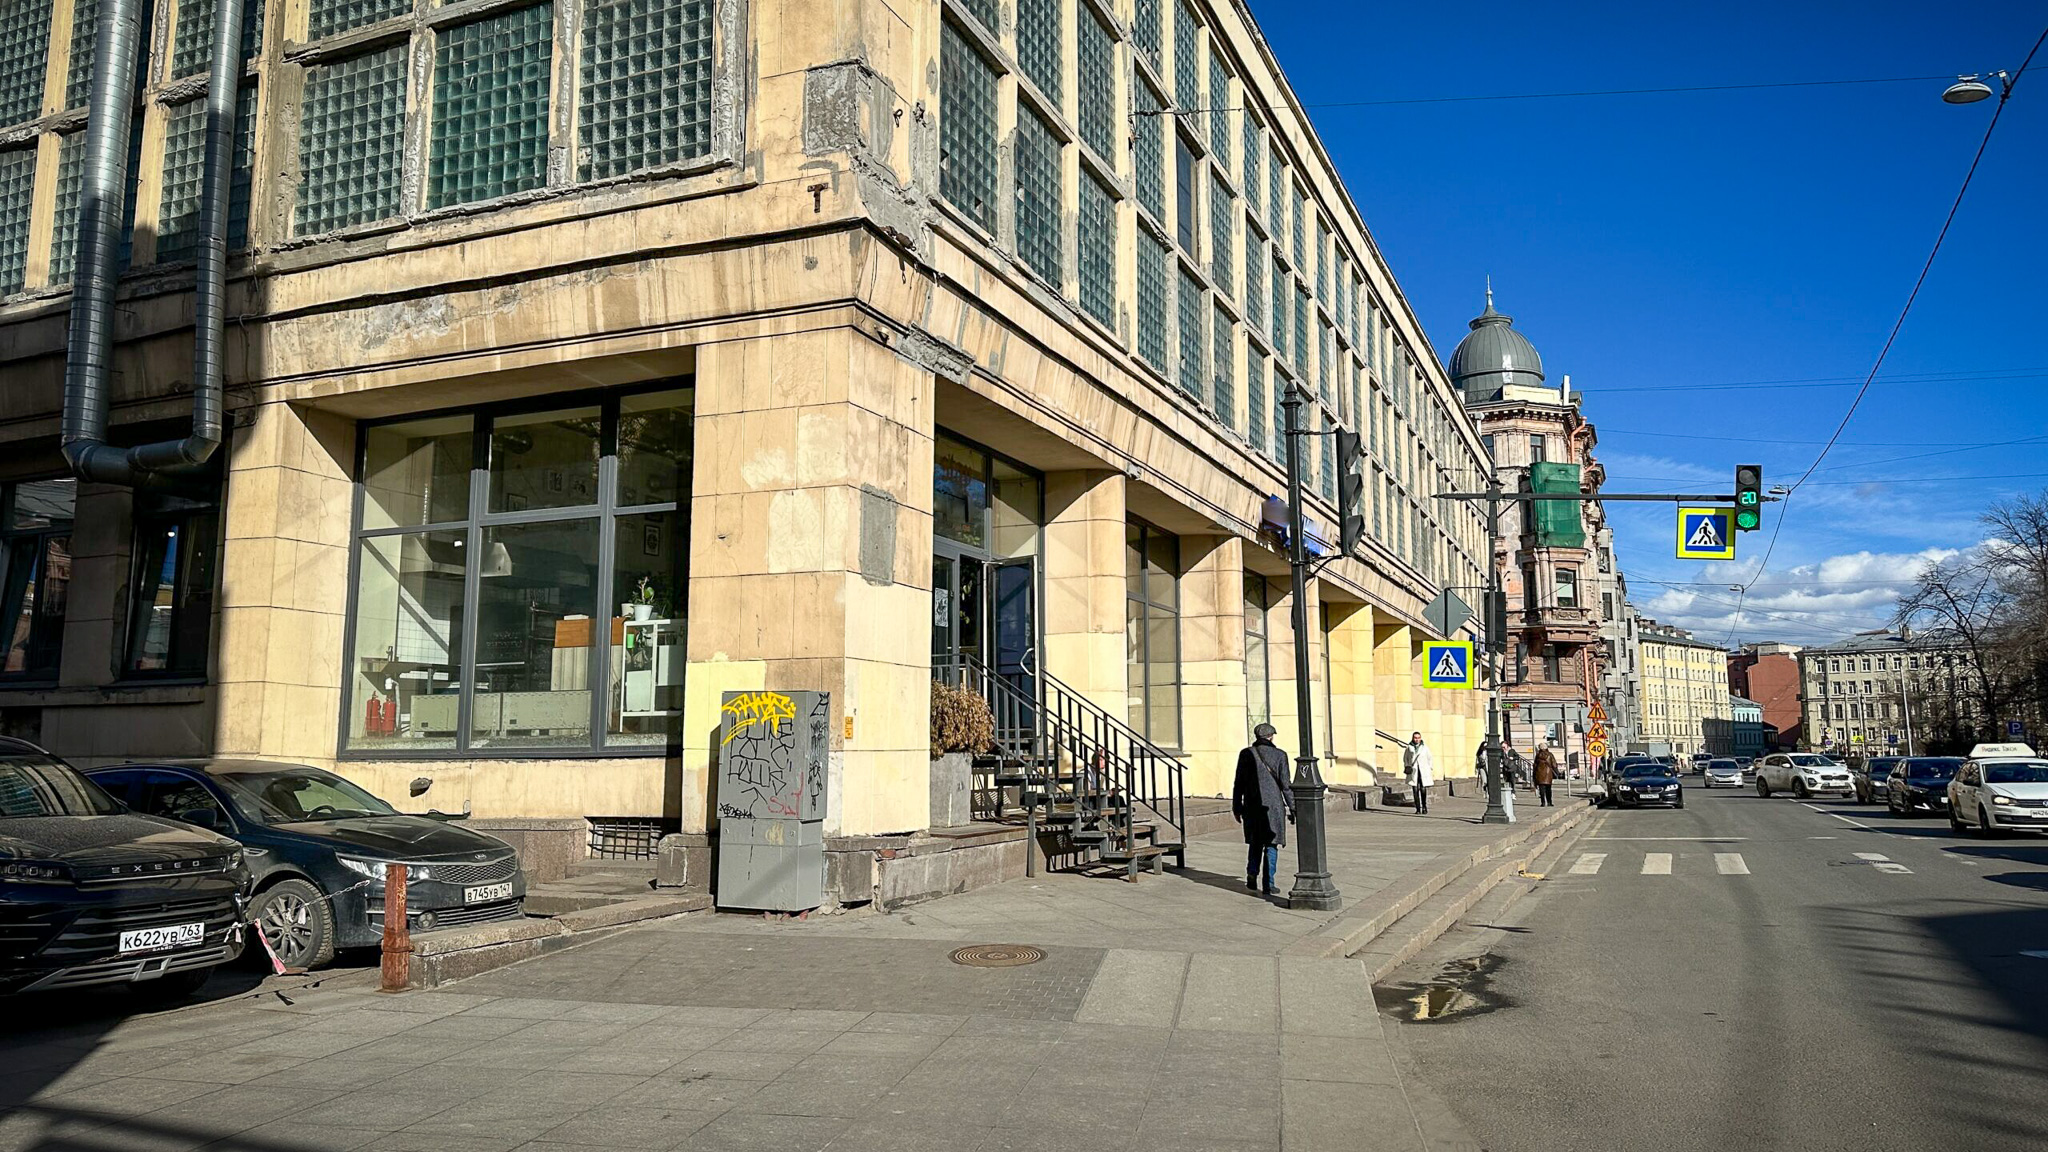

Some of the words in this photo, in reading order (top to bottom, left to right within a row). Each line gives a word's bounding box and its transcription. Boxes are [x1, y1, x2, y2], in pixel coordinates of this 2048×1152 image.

[1742, 492, 1757, 504] 20
[1591, 745, 1602, 753] 40
[111, 860, 200, 874] EXEED
